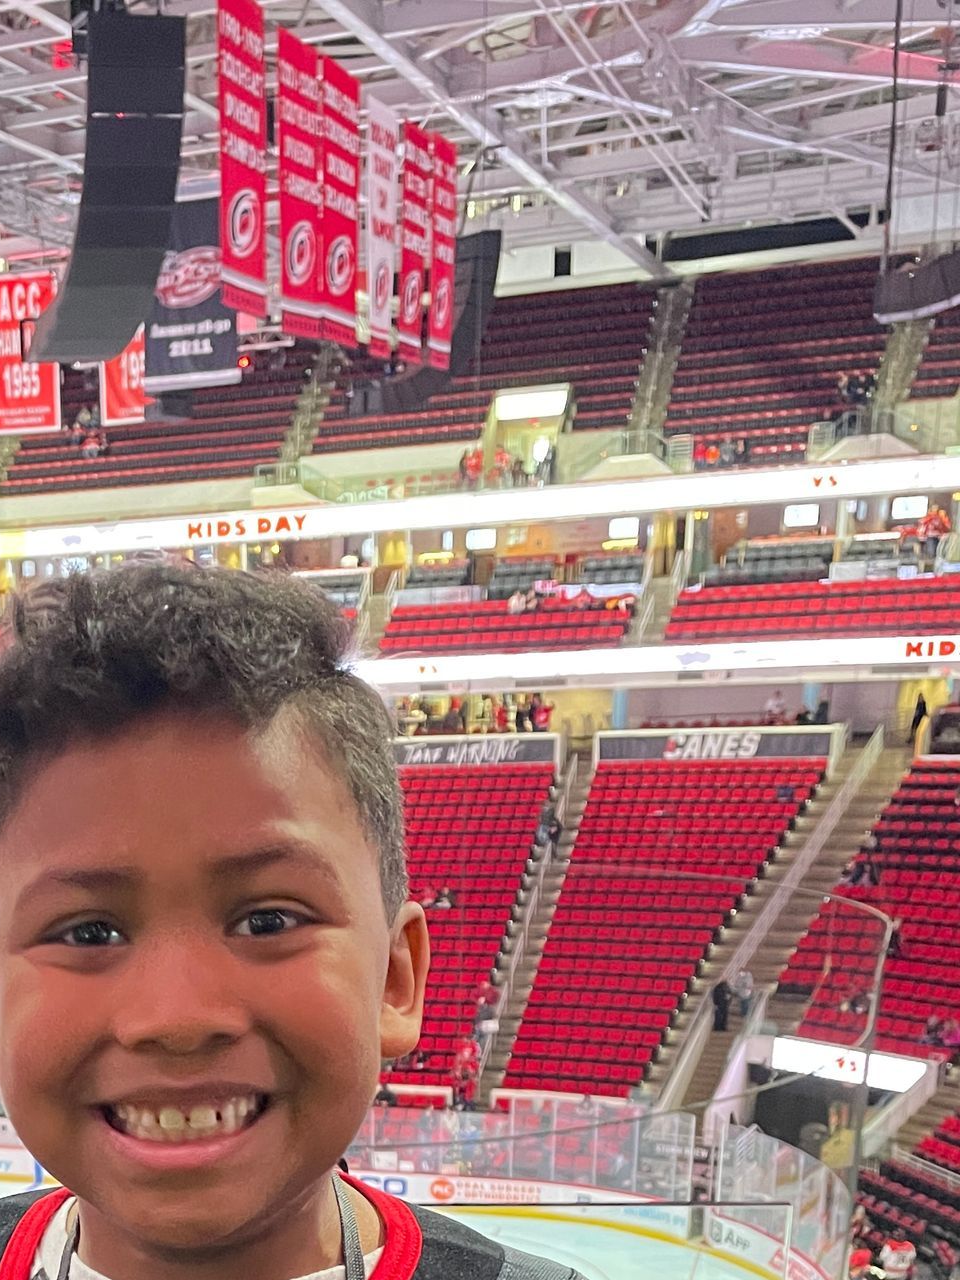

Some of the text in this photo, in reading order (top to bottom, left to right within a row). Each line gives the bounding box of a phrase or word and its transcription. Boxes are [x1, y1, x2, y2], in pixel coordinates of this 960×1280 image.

[188, 514, 307, 539] KIDS DAY
[905, 641, 960, 657] KID
[446, 738, 526, 767] WARNING
[662, 733, 763, 760] CANES
